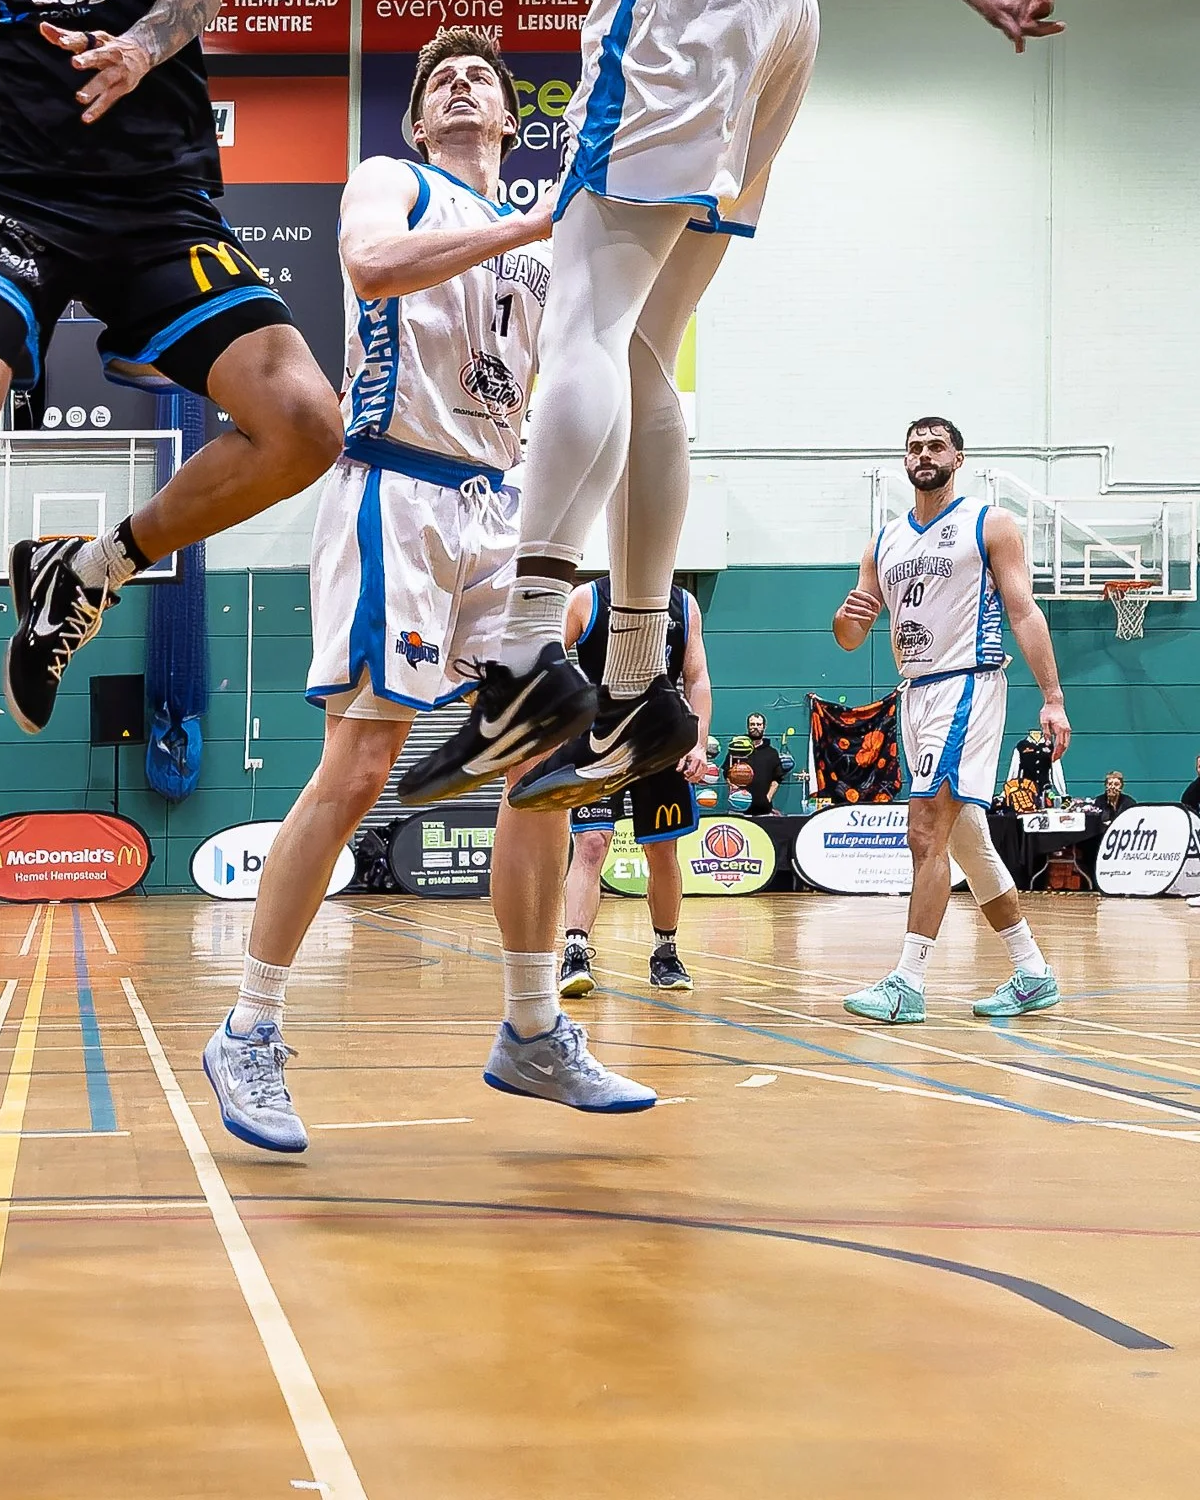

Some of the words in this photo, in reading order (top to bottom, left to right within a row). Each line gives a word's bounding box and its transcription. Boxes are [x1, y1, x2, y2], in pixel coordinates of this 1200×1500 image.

[245, 15, 313, 32] CENTRE
[271, 226, 312, 241] AND
[901, 581, 925, 608] 40
[847, 810, 910, 827] Sterlin
[825, 834, 896, 847] Independent
[1102, 818, 1157, 861] gpfm
[6, 848, 115, 866] McDonald's
[692, 859, 719, 873] the
[720, 859, 760, 873] certa
[15, 871, 48, 882] Hemel
[50, 870, 107, 882] Hempstead
